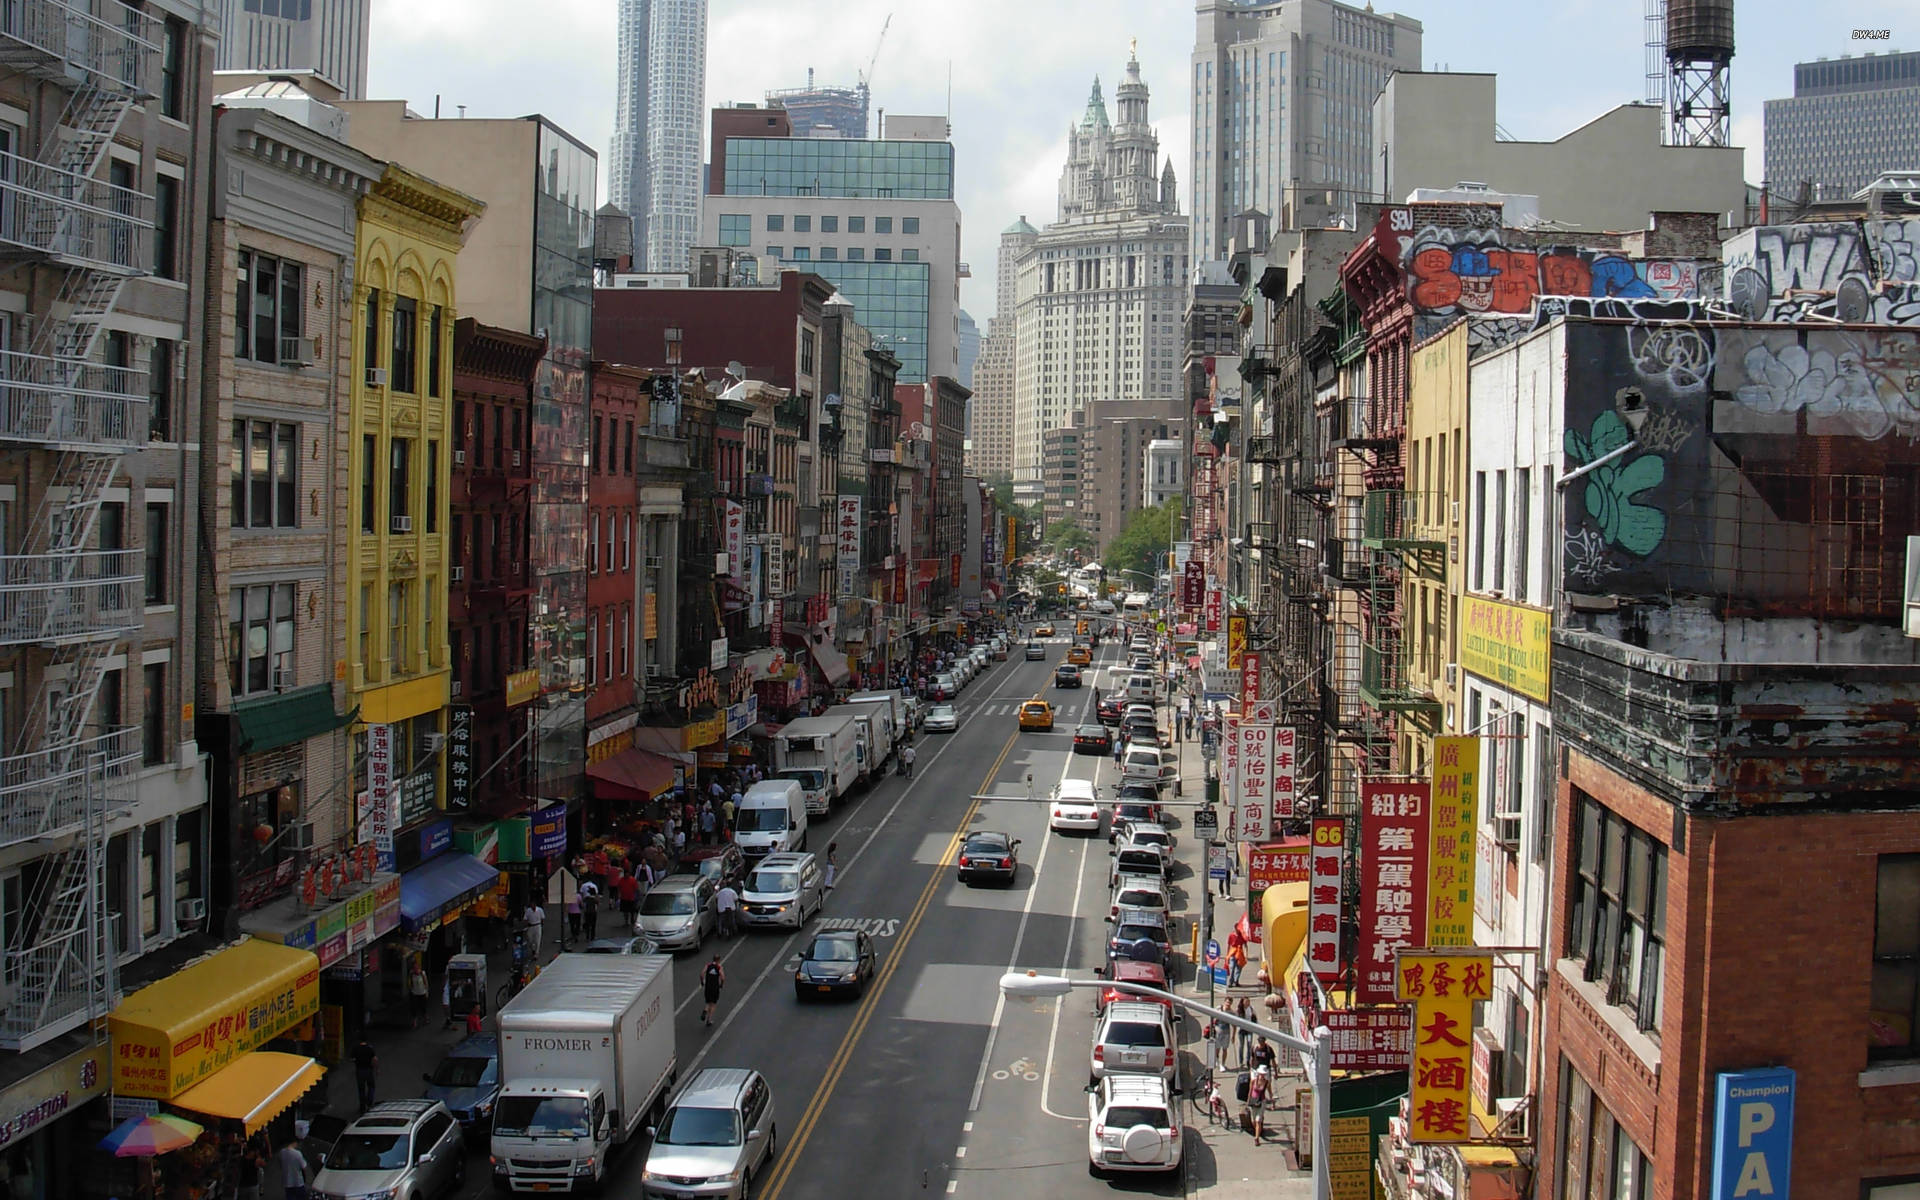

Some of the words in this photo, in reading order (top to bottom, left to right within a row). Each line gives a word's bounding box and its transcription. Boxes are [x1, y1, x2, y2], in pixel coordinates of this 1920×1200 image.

[1371, 792, 1421, 817] 紐約
[1315, 826, 1342, 844] 66
[1433, 743, 1460, 920] 廣州駕駛學校
[524, 1038, 592, 1051] FROMER
[1415, 1011, 1469, 1135] 大酒樓
[1729, 1085, 1790, 1098] Champion
